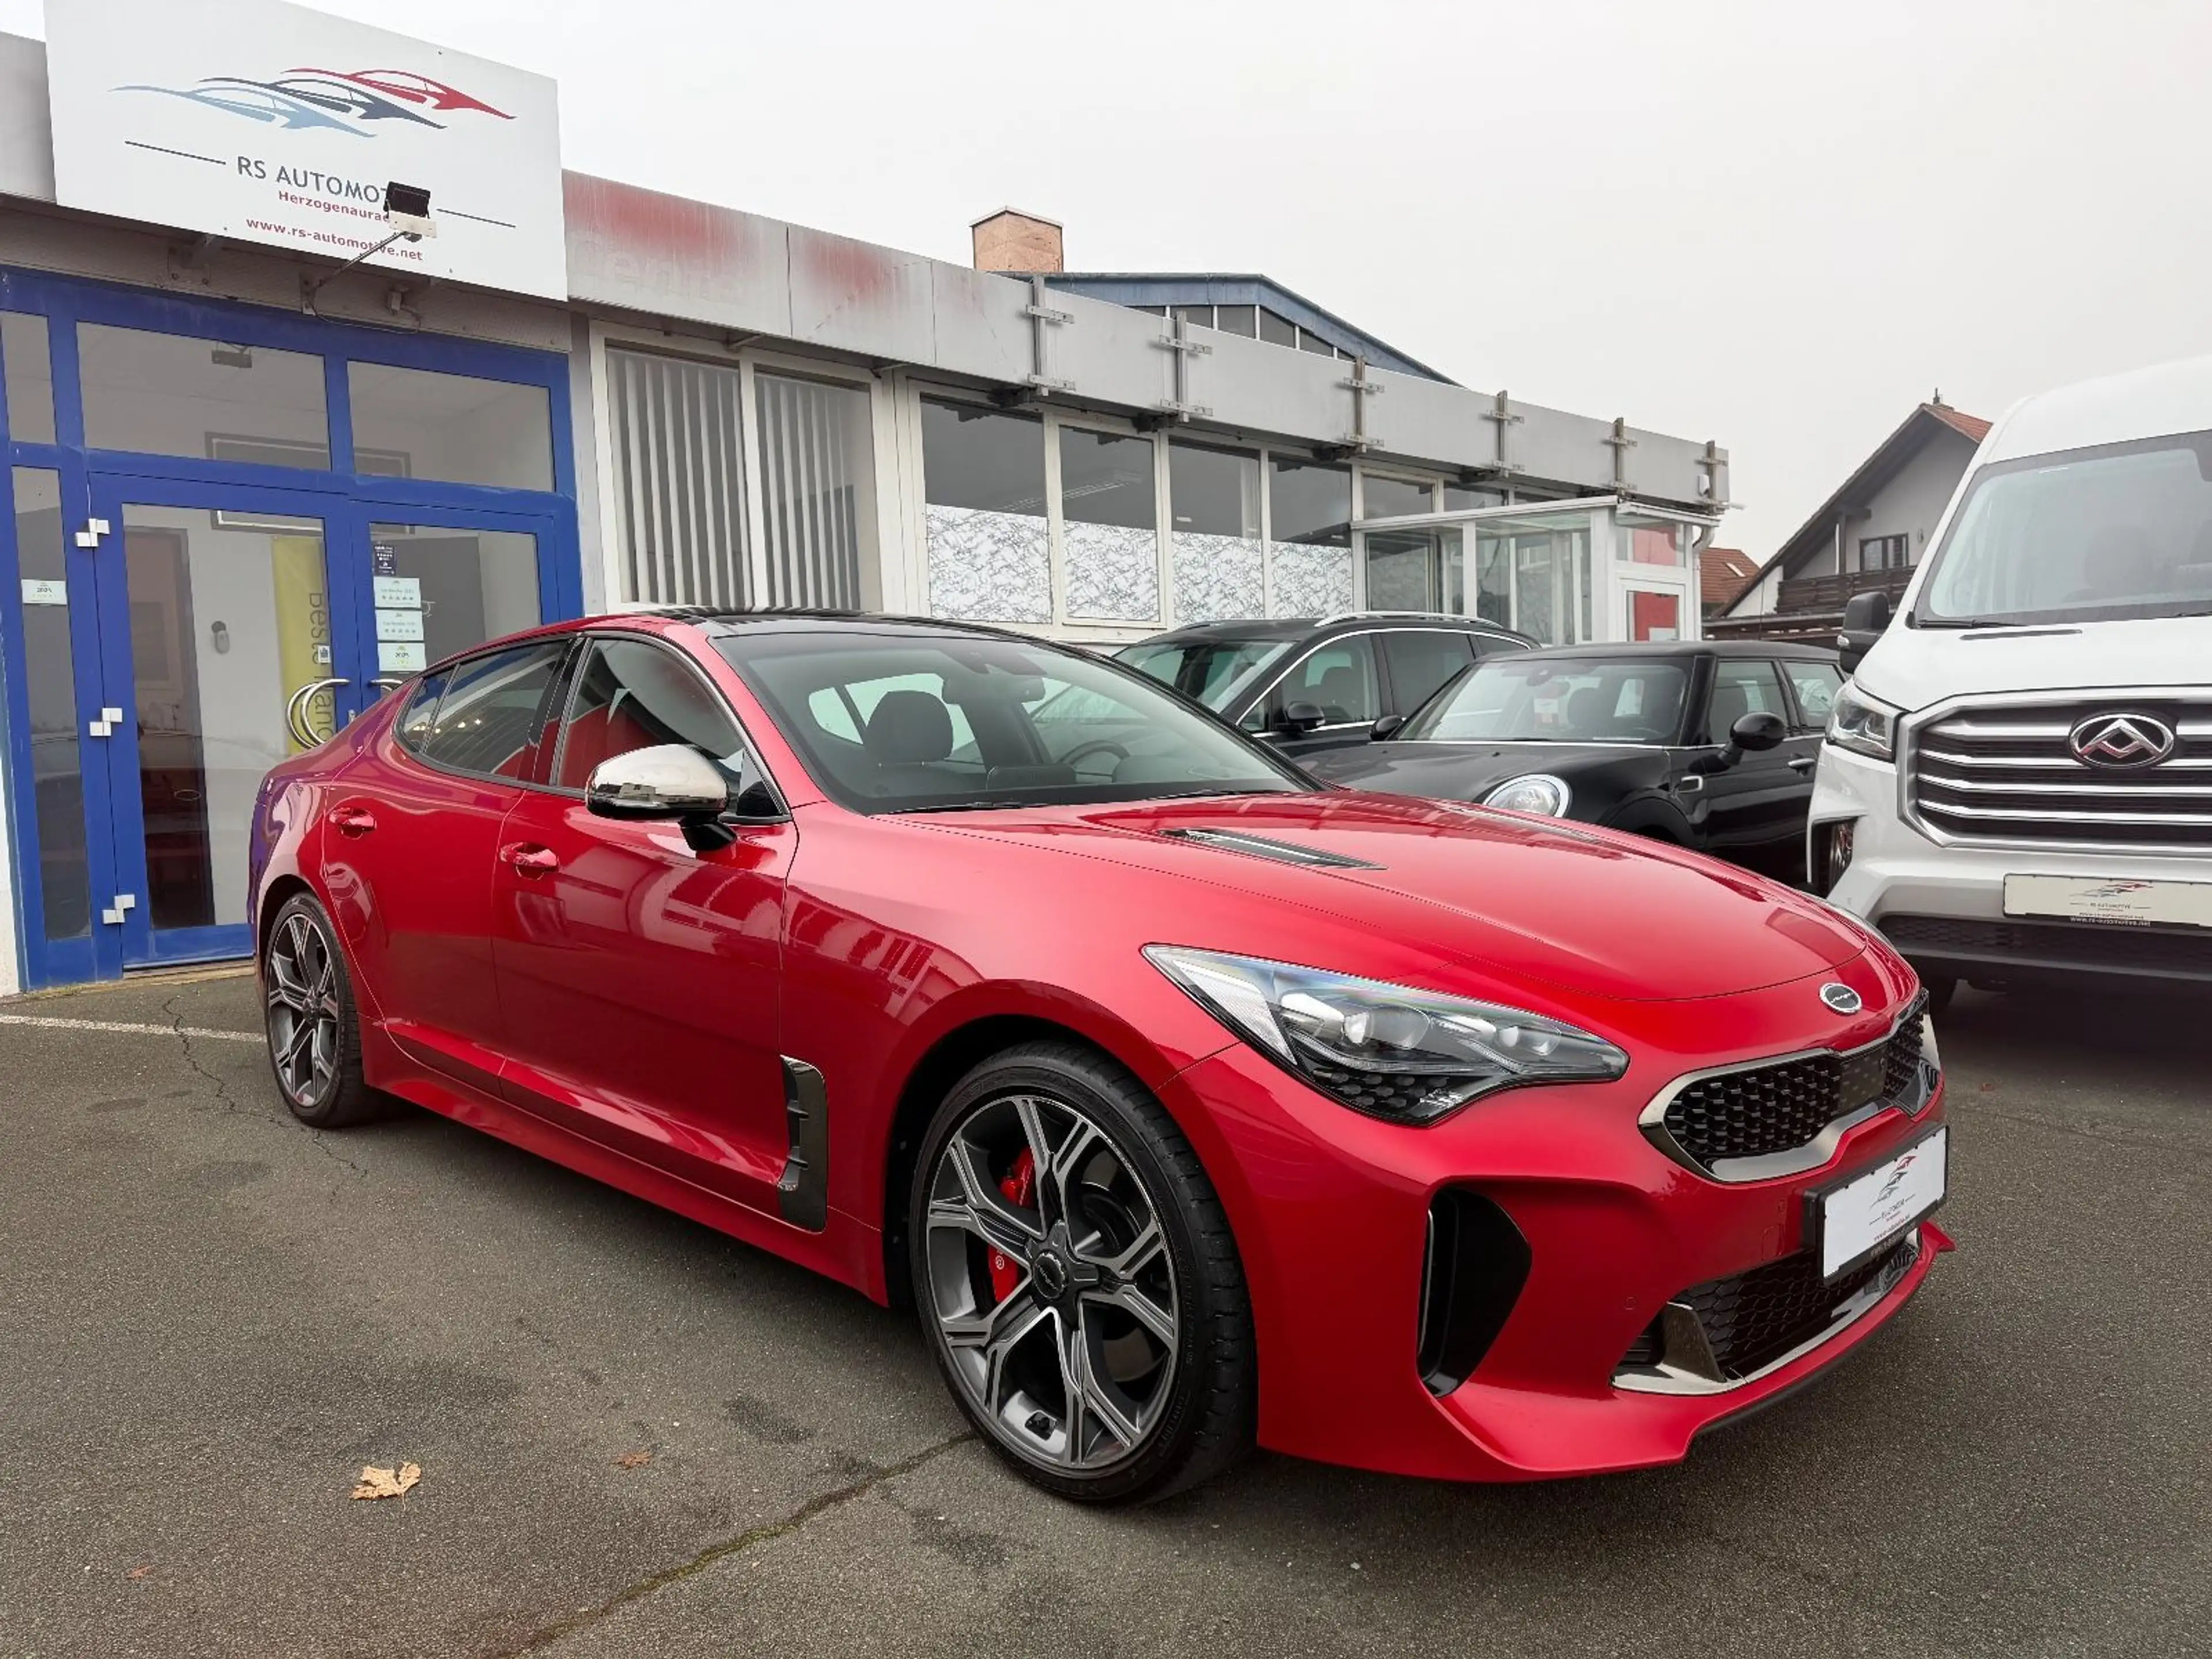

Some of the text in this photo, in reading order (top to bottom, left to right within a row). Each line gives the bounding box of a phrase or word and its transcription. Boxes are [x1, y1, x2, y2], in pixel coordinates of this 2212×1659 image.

[237, 156, 387, 203] RS AUTOMO
[278, 191, 391, 224] Herzogenaurac
